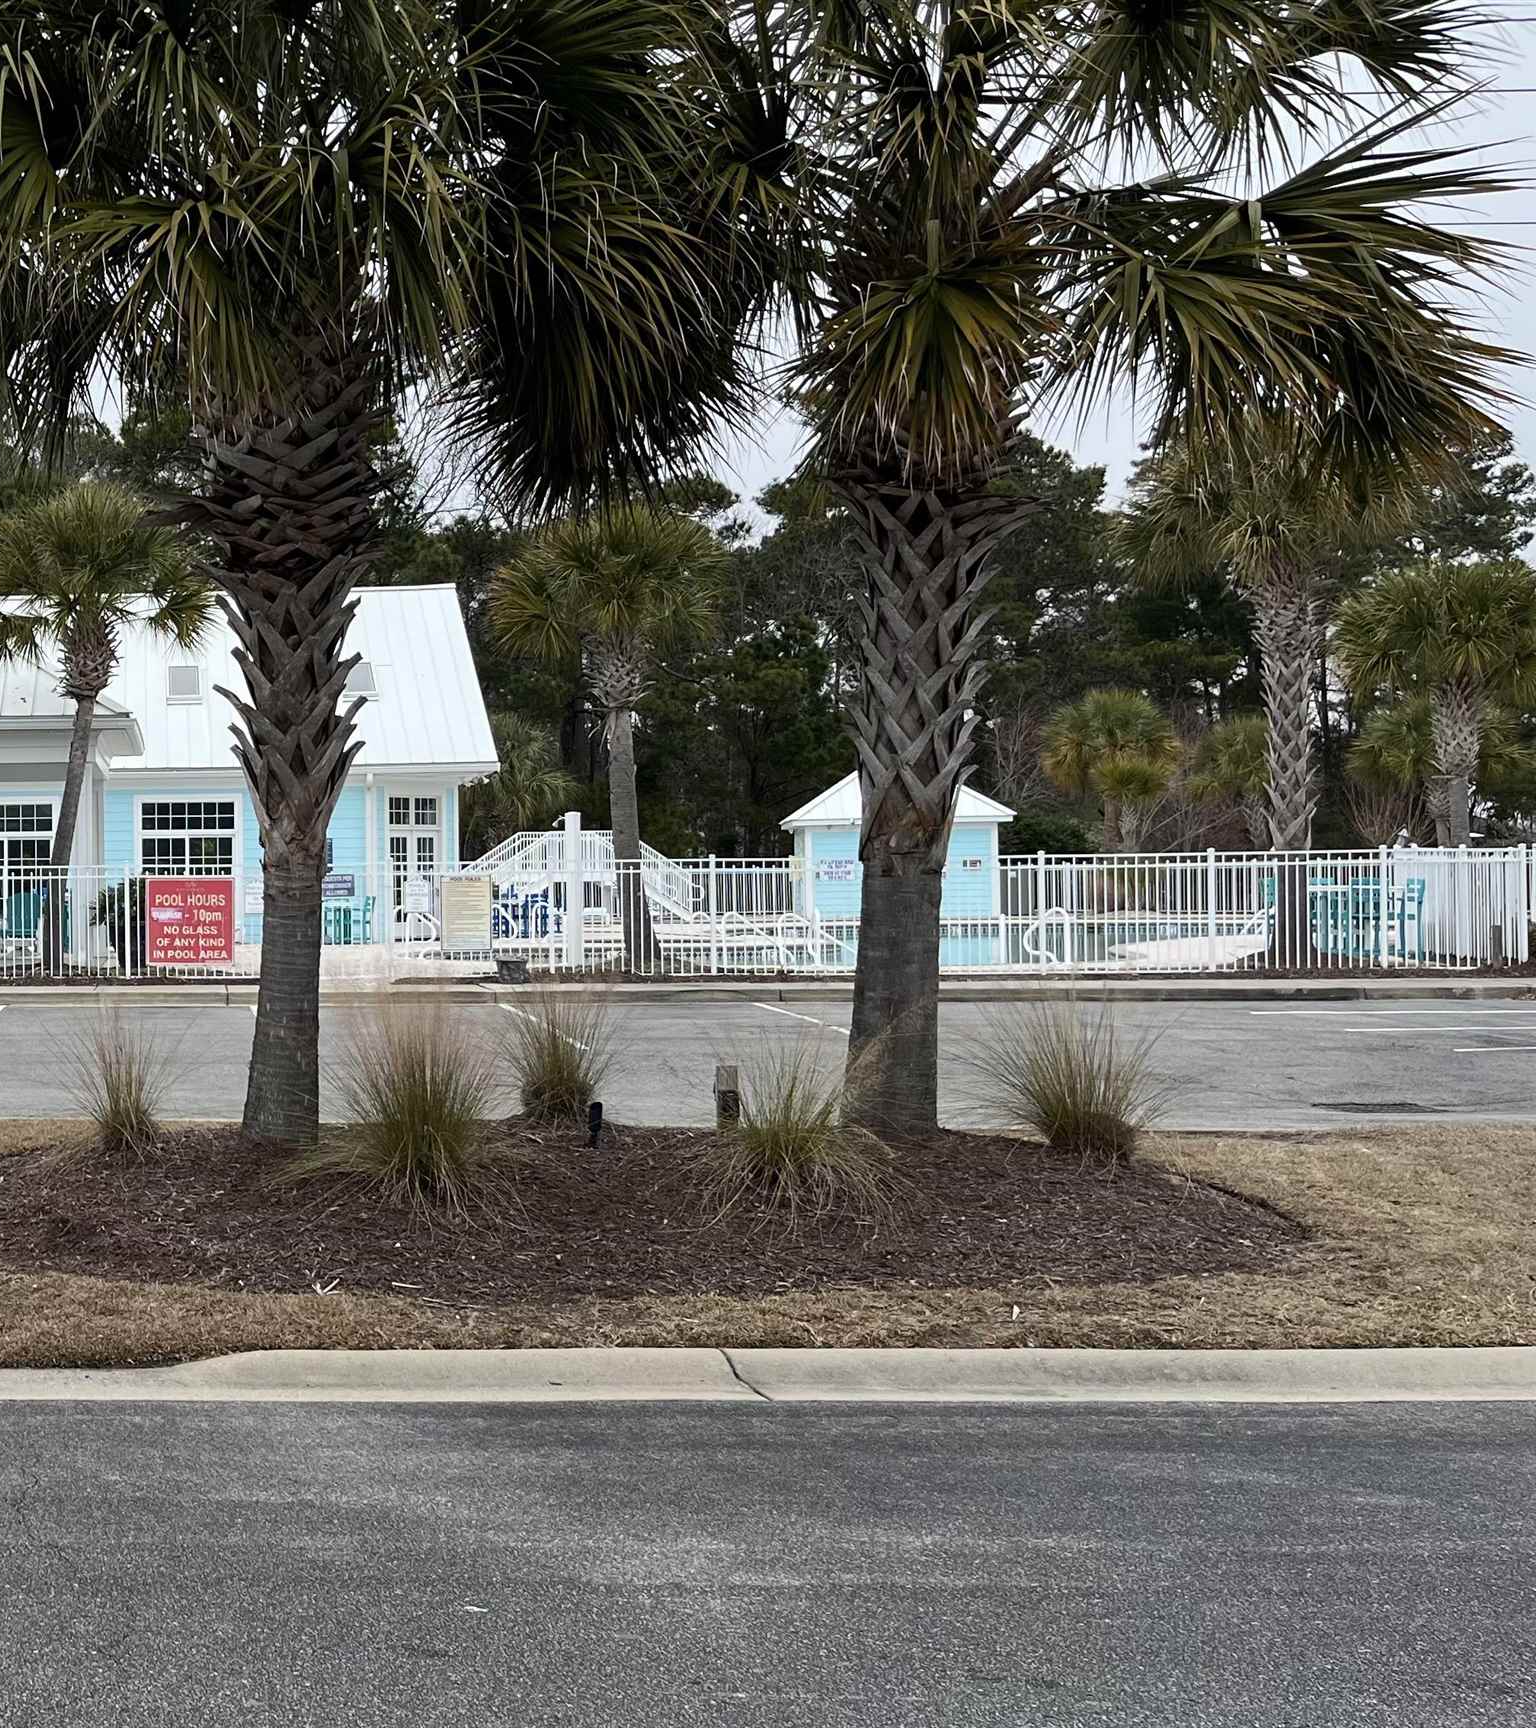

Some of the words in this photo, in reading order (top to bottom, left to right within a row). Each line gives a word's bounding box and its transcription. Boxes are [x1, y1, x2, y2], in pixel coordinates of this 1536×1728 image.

[155, 894, 184, 906] POOL
[187, 894, 226, 906] HOURS
[192, 909, 222, 923] 10pm
[163, 926, 179, 935] NO
[182, 926, 218, 935] GLASS
[156, 938, 171, 947] OF
[173, 938, 195, 947] ANY
[199, 938, 225, 947] KIND
[153, 950, 165, 959] IN
[167, 950, 196, 959] POOL
[199, 950, 228, 959] AREA
